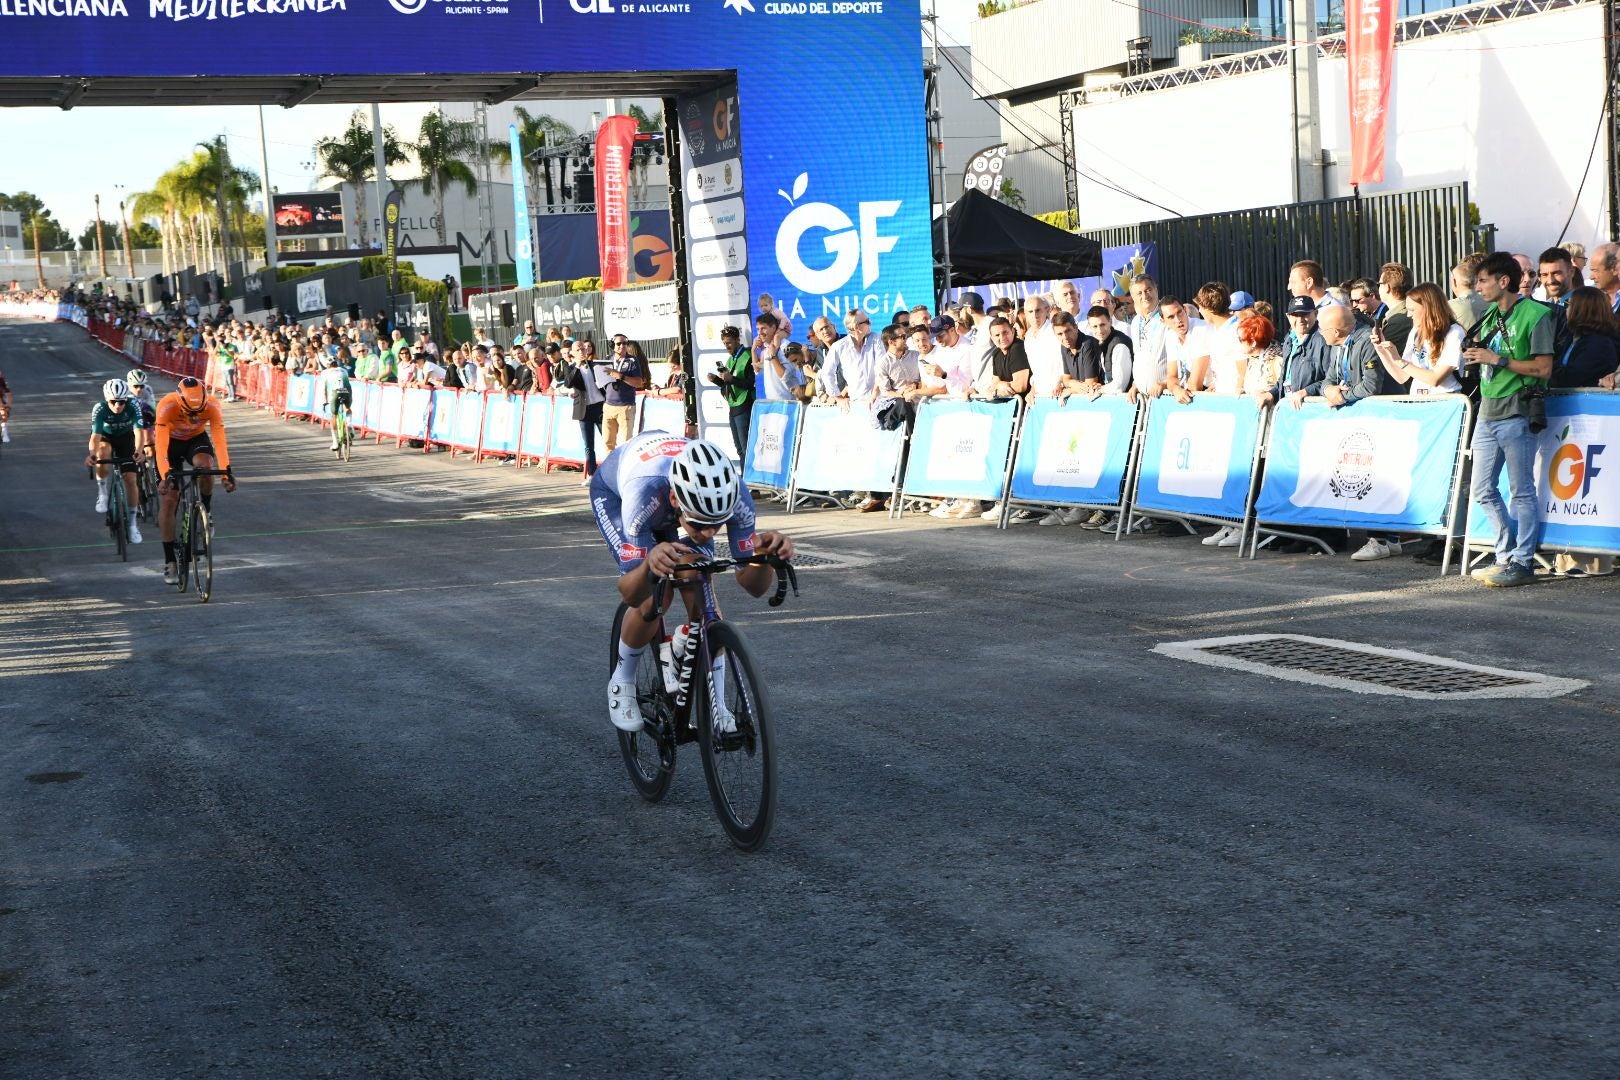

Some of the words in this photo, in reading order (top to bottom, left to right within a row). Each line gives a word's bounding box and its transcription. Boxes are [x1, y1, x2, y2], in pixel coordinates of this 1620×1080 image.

[0, 0, 129, 17] LENCIANA
[445, 6, 482, 14] ALICANTE
[486, 6, 509, 14] SPAIN
[621, 4, 635, 13] DE
[638, 4, 691, 13] ALICANTE
[764, 3, 807, 15] CIUDAD
[809, 2, 830, 14] DEL
[832, 2, 883, 14] DEPORTE
[605, 145, 623, 226] CRITERIUM
[775, 199, 903, 296] GF
[1549, 443, 1607, 501] GF
[1546, 501, 1557, 514] LA
[676, 621, 700, 707] CANYON
